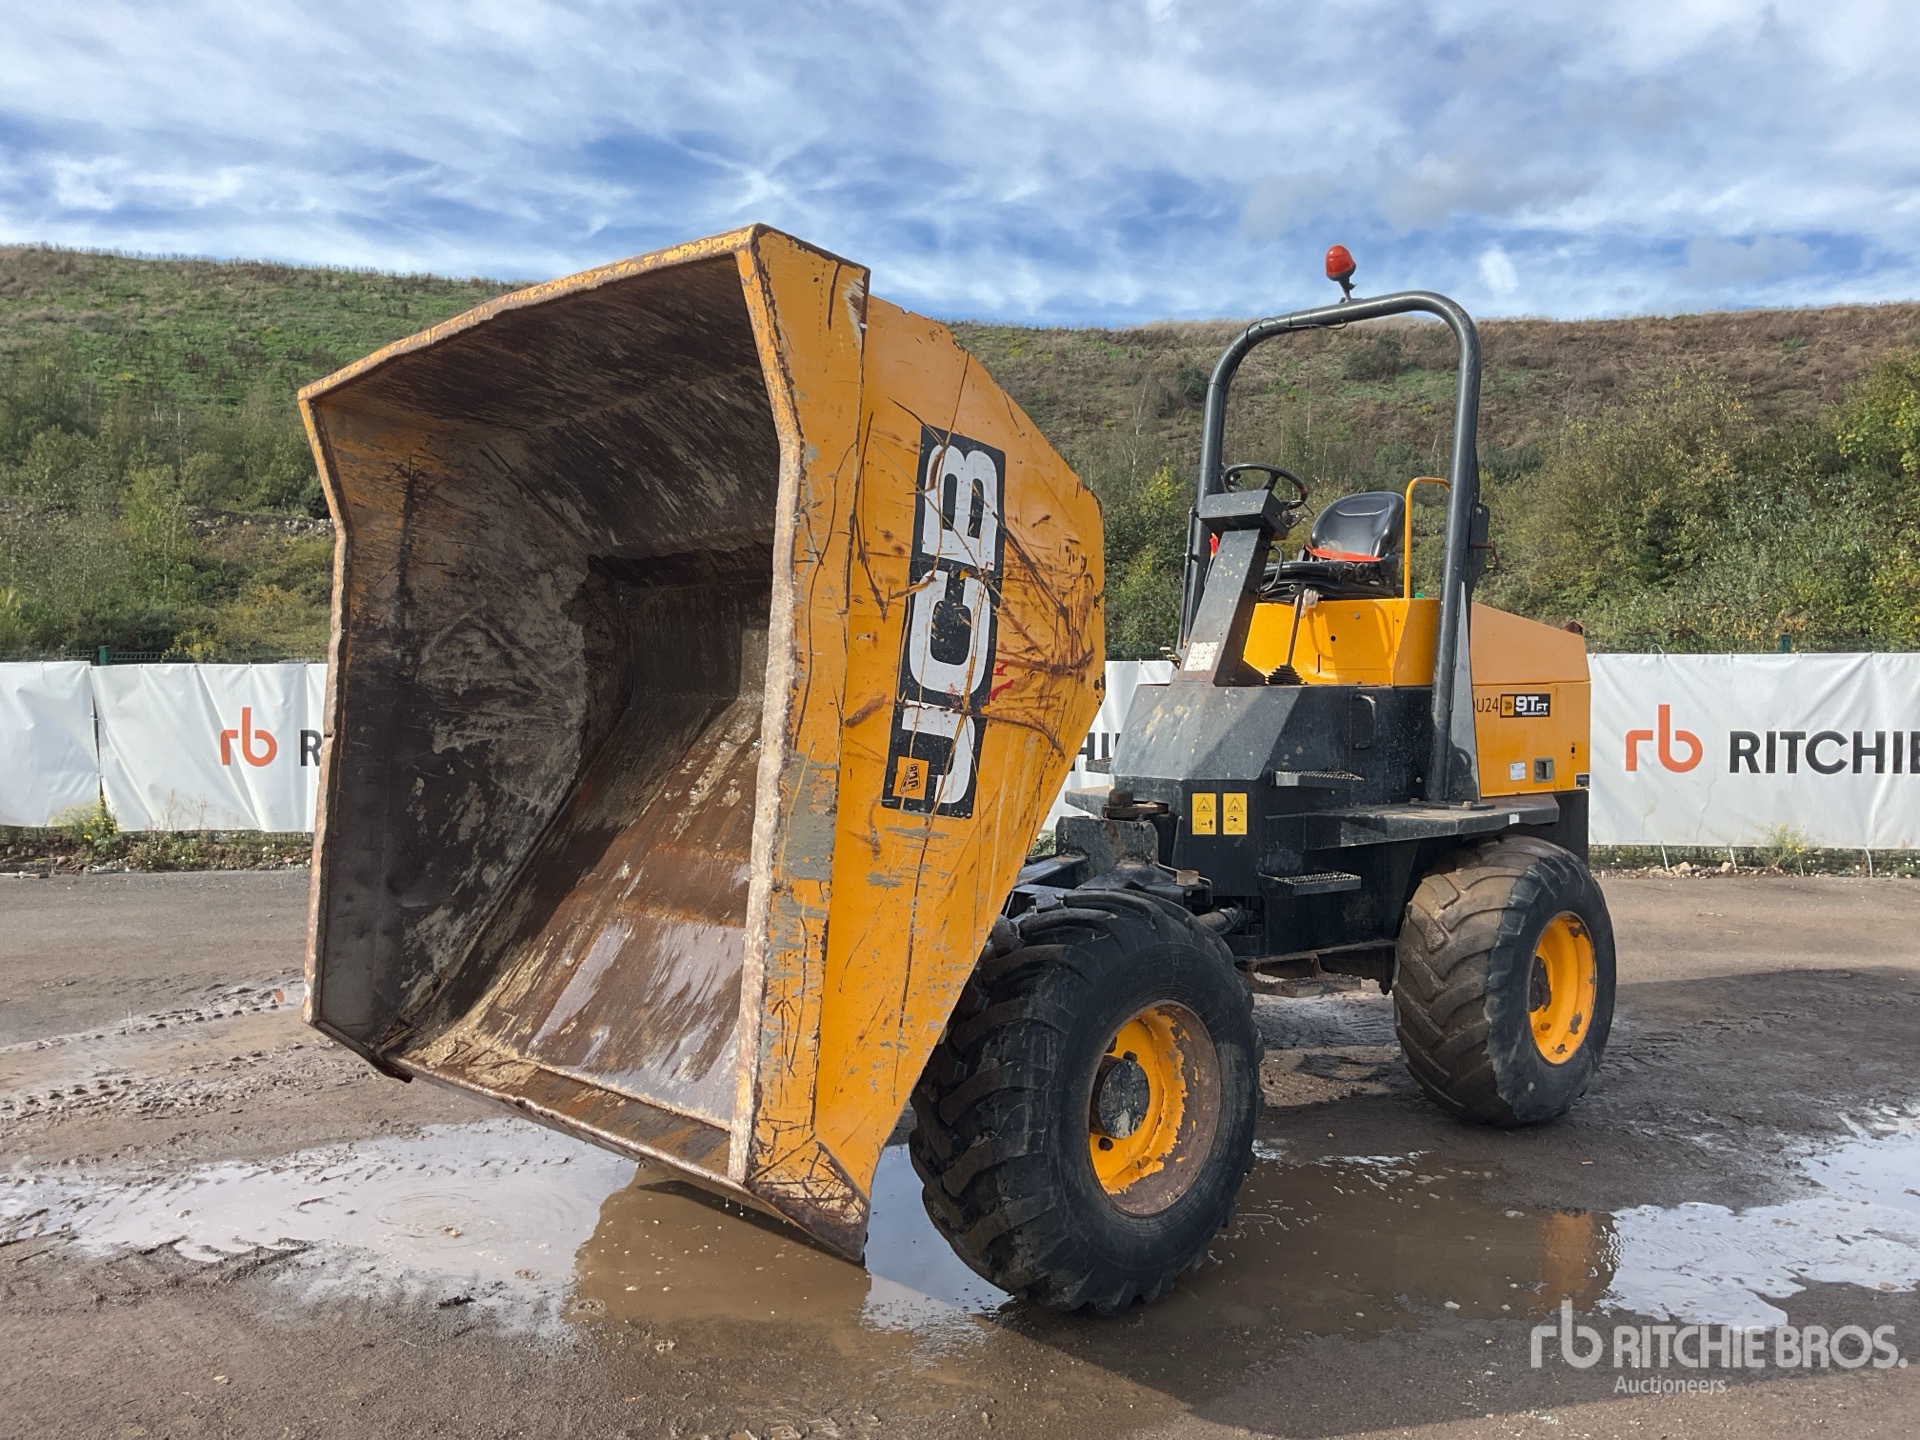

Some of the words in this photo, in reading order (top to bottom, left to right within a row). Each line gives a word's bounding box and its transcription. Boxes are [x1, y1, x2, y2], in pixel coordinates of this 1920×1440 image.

[901, 443, 998, 804] JCB
[220, 706, 278, 767] rb
[1472, 697, 1499, 713] U24
[1625, 703, 1704, 773] rb
